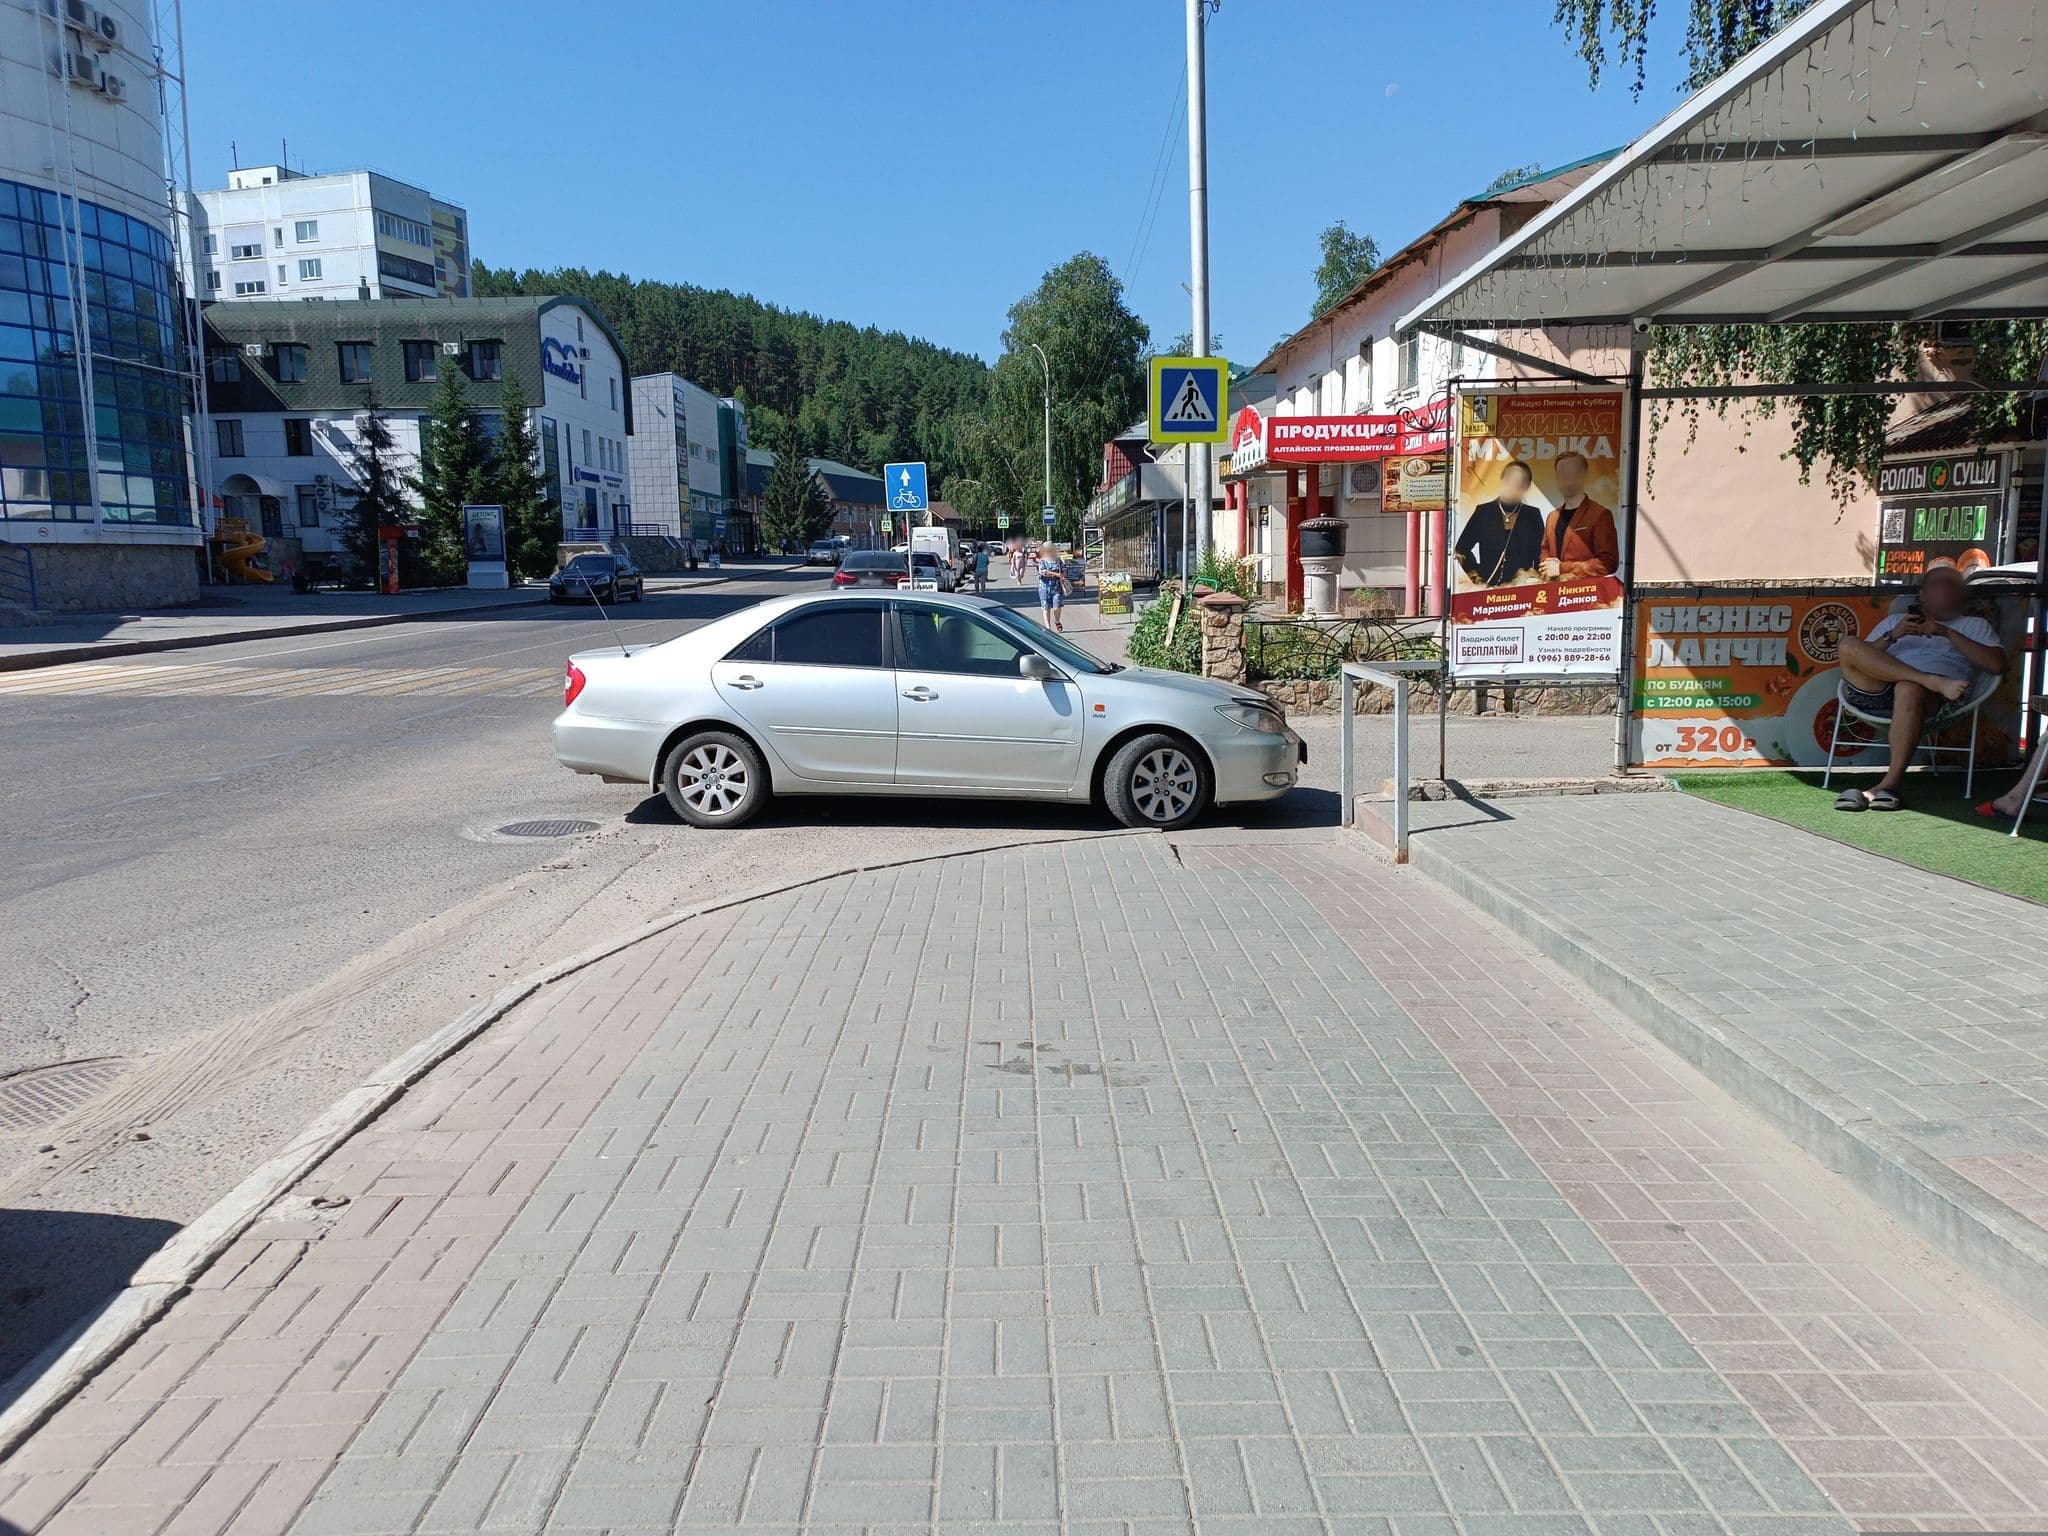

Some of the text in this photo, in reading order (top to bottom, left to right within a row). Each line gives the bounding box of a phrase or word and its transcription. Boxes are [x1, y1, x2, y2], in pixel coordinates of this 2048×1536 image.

[1511, 400, 1542, 408] Каждую
[1543, 399, 1575, 407] Пятницу
[1583, 398, 1616, 406] Субботу
[1501, 412, 1615, 436] ЖИВАЯ
[1275, 423, 1397, 440] ПРОДУКЦИЯ
[1274, 443, 1395, 453] АЛТАЙСКИХ ПРОИЗВОДИТЕЛЕЙ
[1468, 436, 1614, 461] МУЗЫКА
[1880, 460, 1996, 492] РОЛЛЫ СУШИ
[1913, 505, 1988, 541] ВАСАБИ
[1887, 551, 1925, 562] ДАРИМ
[1886, 563, 1924, 574] РОЛЛЫ
[1558, 583, 1597, 595] Никита
[1486, 594, 1517, 604] Маша
[1558, 595, 1598, 607] Дьяков
[1472, 602, 1532, 616] Маринович
[1650, 605, 1792, 633] БИЗНЕС
[1803, 606, 1856, 631] БАВАРЕНОК
[1460, 635, 1520, 643] Входной билет
[1545, 633, 1569, 641] 20:00
[1586, 633, 1612, 641] 22:00
[1461, 643, 1518, 657] БЕСПЛАТНЫЙ
[1648, 637, 1788, 667] ЛАНЧИ
[1528, 654, 1611, 663] 8 (996) 889-28-66
[1648, 680, 1722, 691] ПО БУДНЯМ
[1647, 696, 1751, 709] с 12:00 до 15:00
[1655, 743, 1672, 752] от
